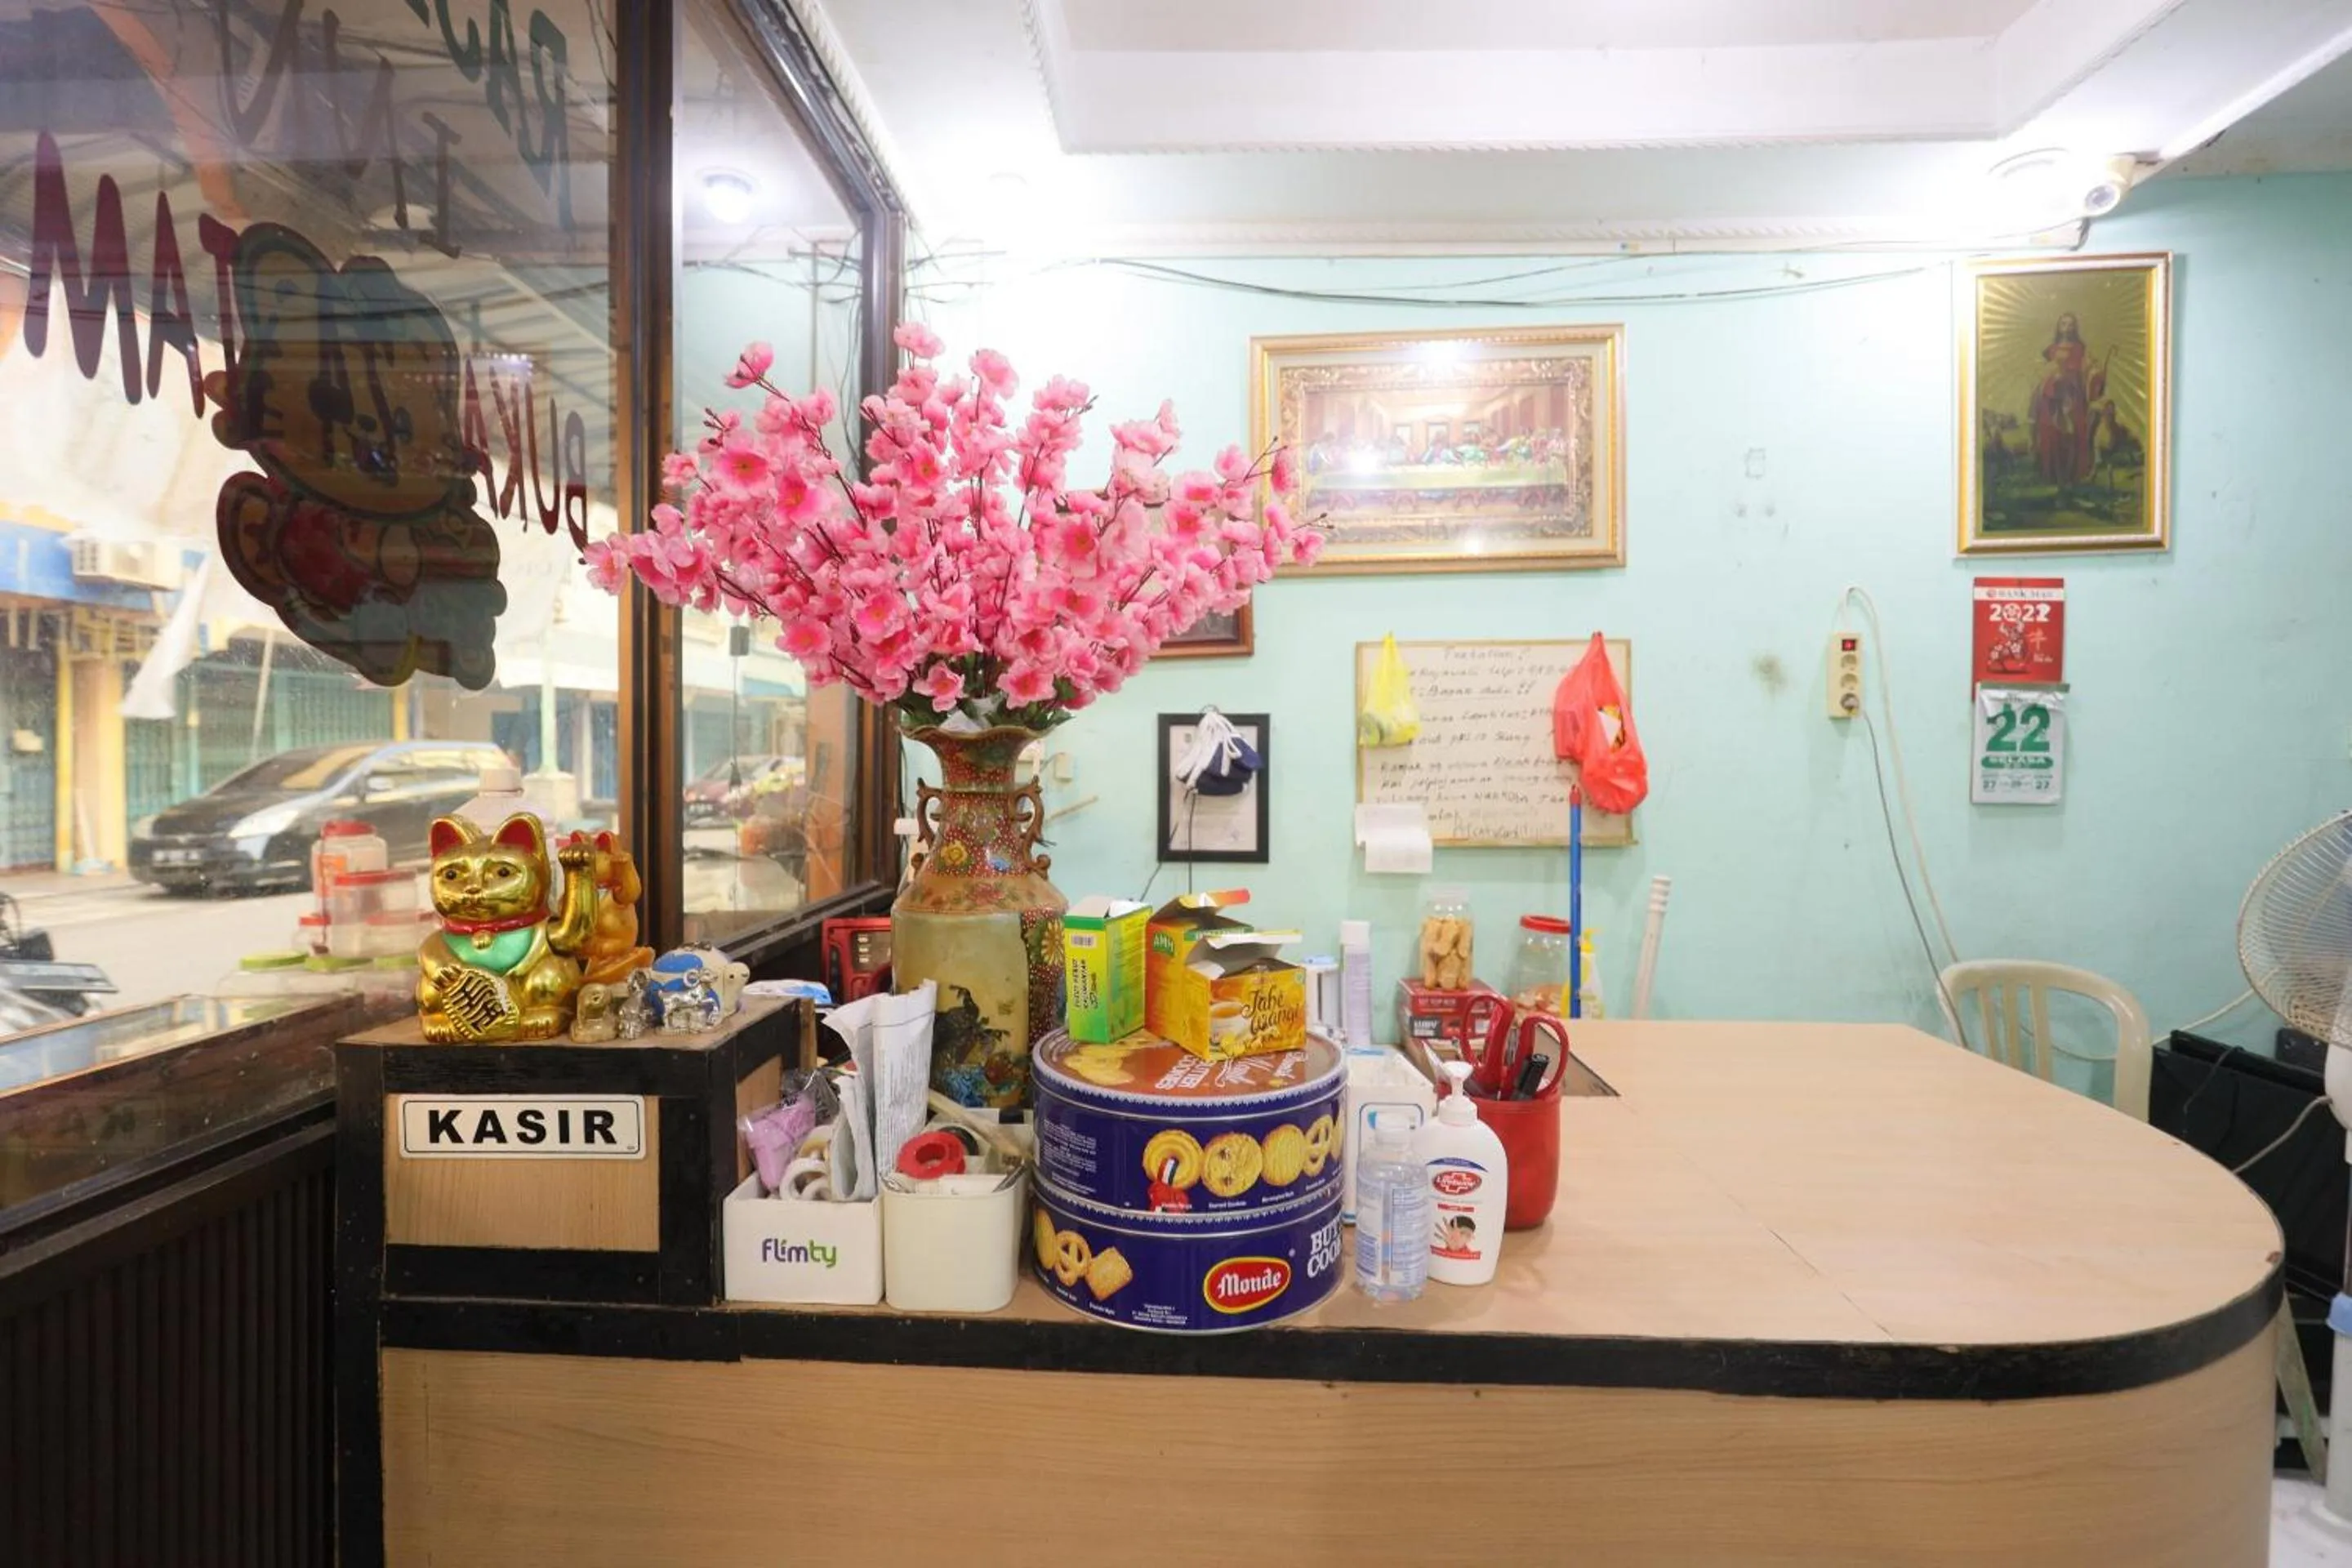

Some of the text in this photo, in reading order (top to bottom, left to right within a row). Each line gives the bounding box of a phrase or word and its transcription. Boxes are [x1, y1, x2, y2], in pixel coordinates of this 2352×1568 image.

[1986, 703, 2050, 752] 22
[1241, 984, 1285, 1018] Jahe
[428, 1109, 617, 1145] KASIR
[1217, 1267, 1282, 1298] Monde
